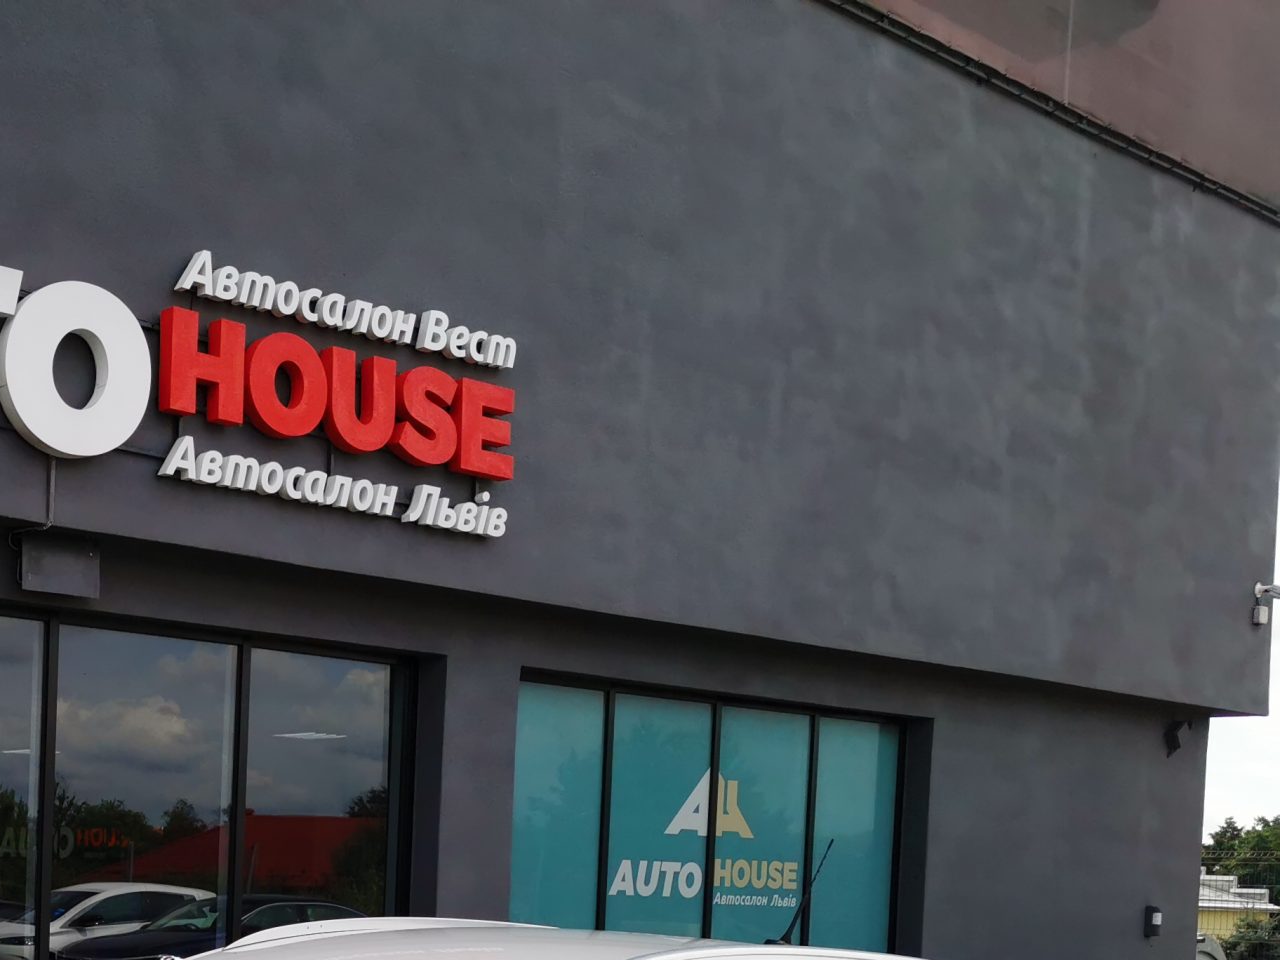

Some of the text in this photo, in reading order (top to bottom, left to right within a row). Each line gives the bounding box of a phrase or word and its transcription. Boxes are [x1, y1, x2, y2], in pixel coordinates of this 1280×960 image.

[173, 249, 517, 369] Автосалон Вест
[158, 305, 516, 481] HOUSE
[157, 435, 508, 538] Автосалон Львів
[608, 858, 799, 898] AUTO HOUSE
[713, 892, 797, 908] Автосалон Львів
